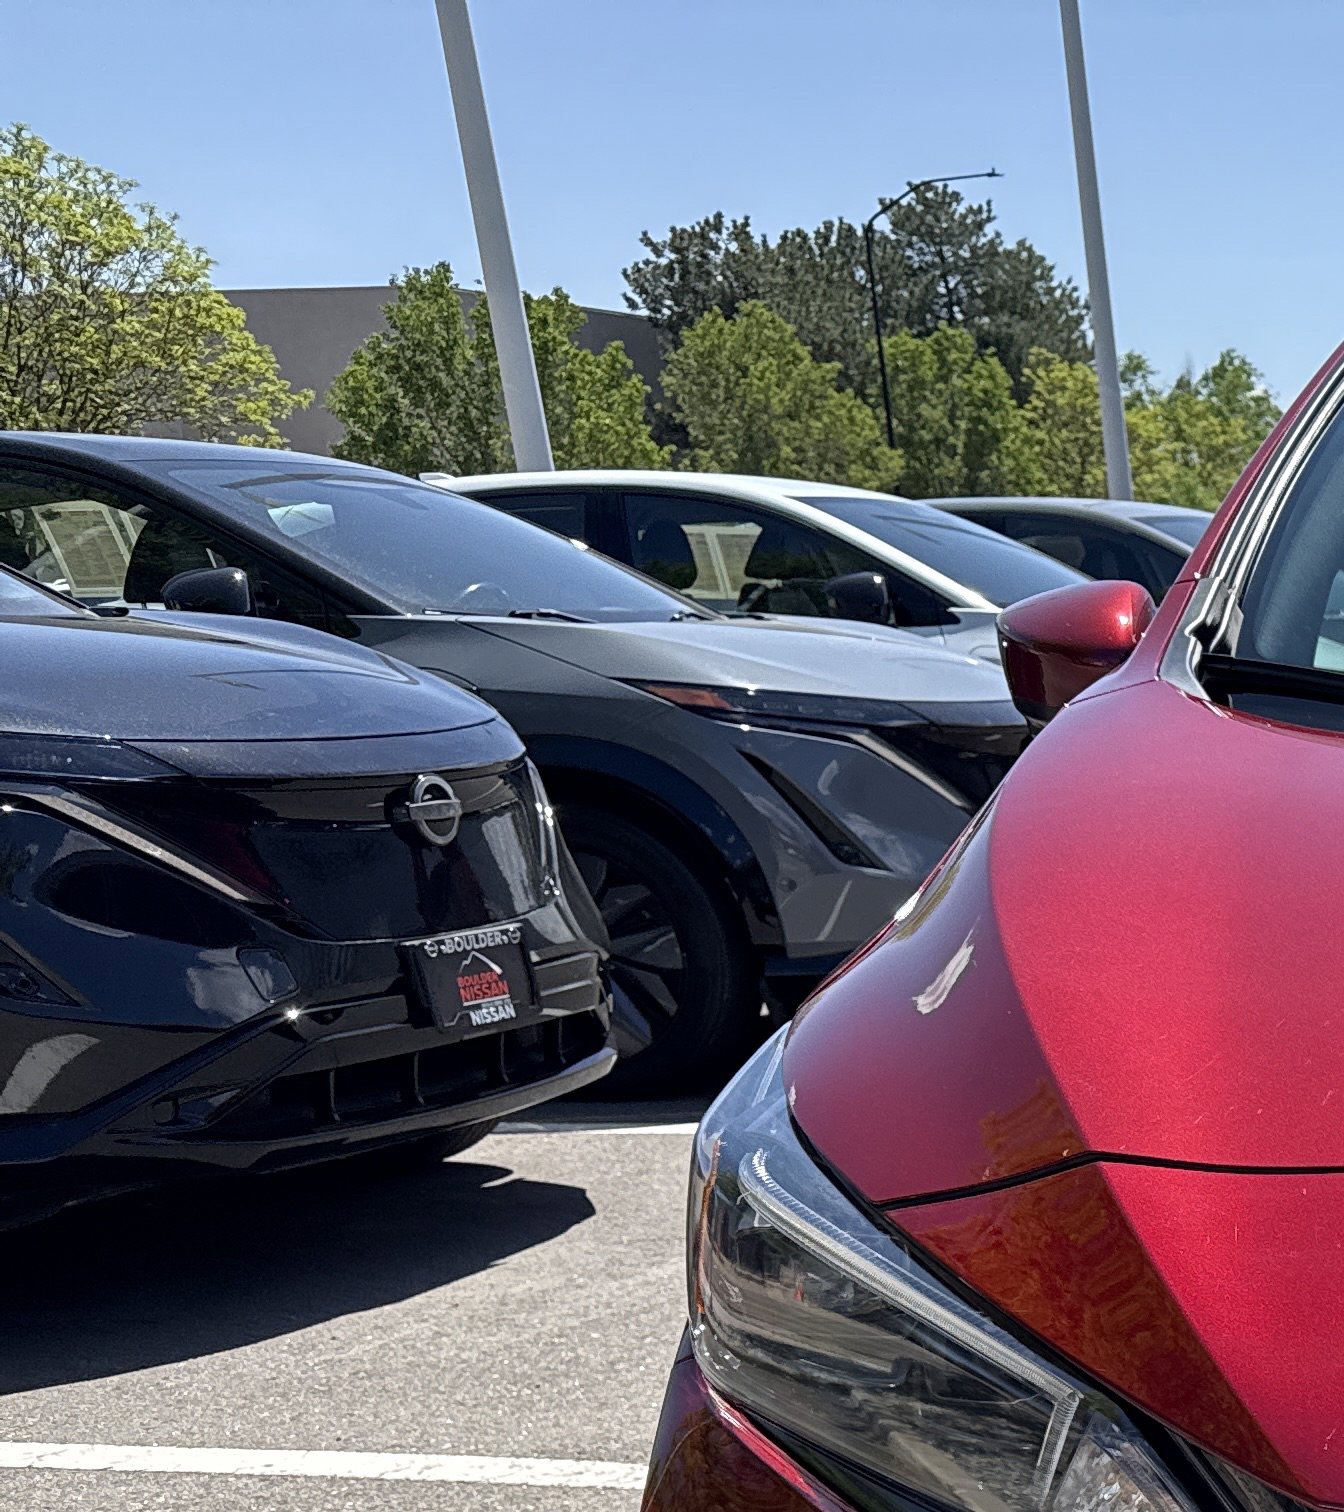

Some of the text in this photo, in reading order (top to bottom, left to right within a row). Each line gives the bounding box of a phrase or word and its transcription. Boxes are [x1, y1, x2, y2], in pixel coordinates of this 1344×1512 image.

[444, 931, 502, 953] BOULDER
[457, 971, 499, 987] BOULDER
[460, 980, 509, 1002] NISSAN
[469, 1003, 516, 1026] NISSAN
